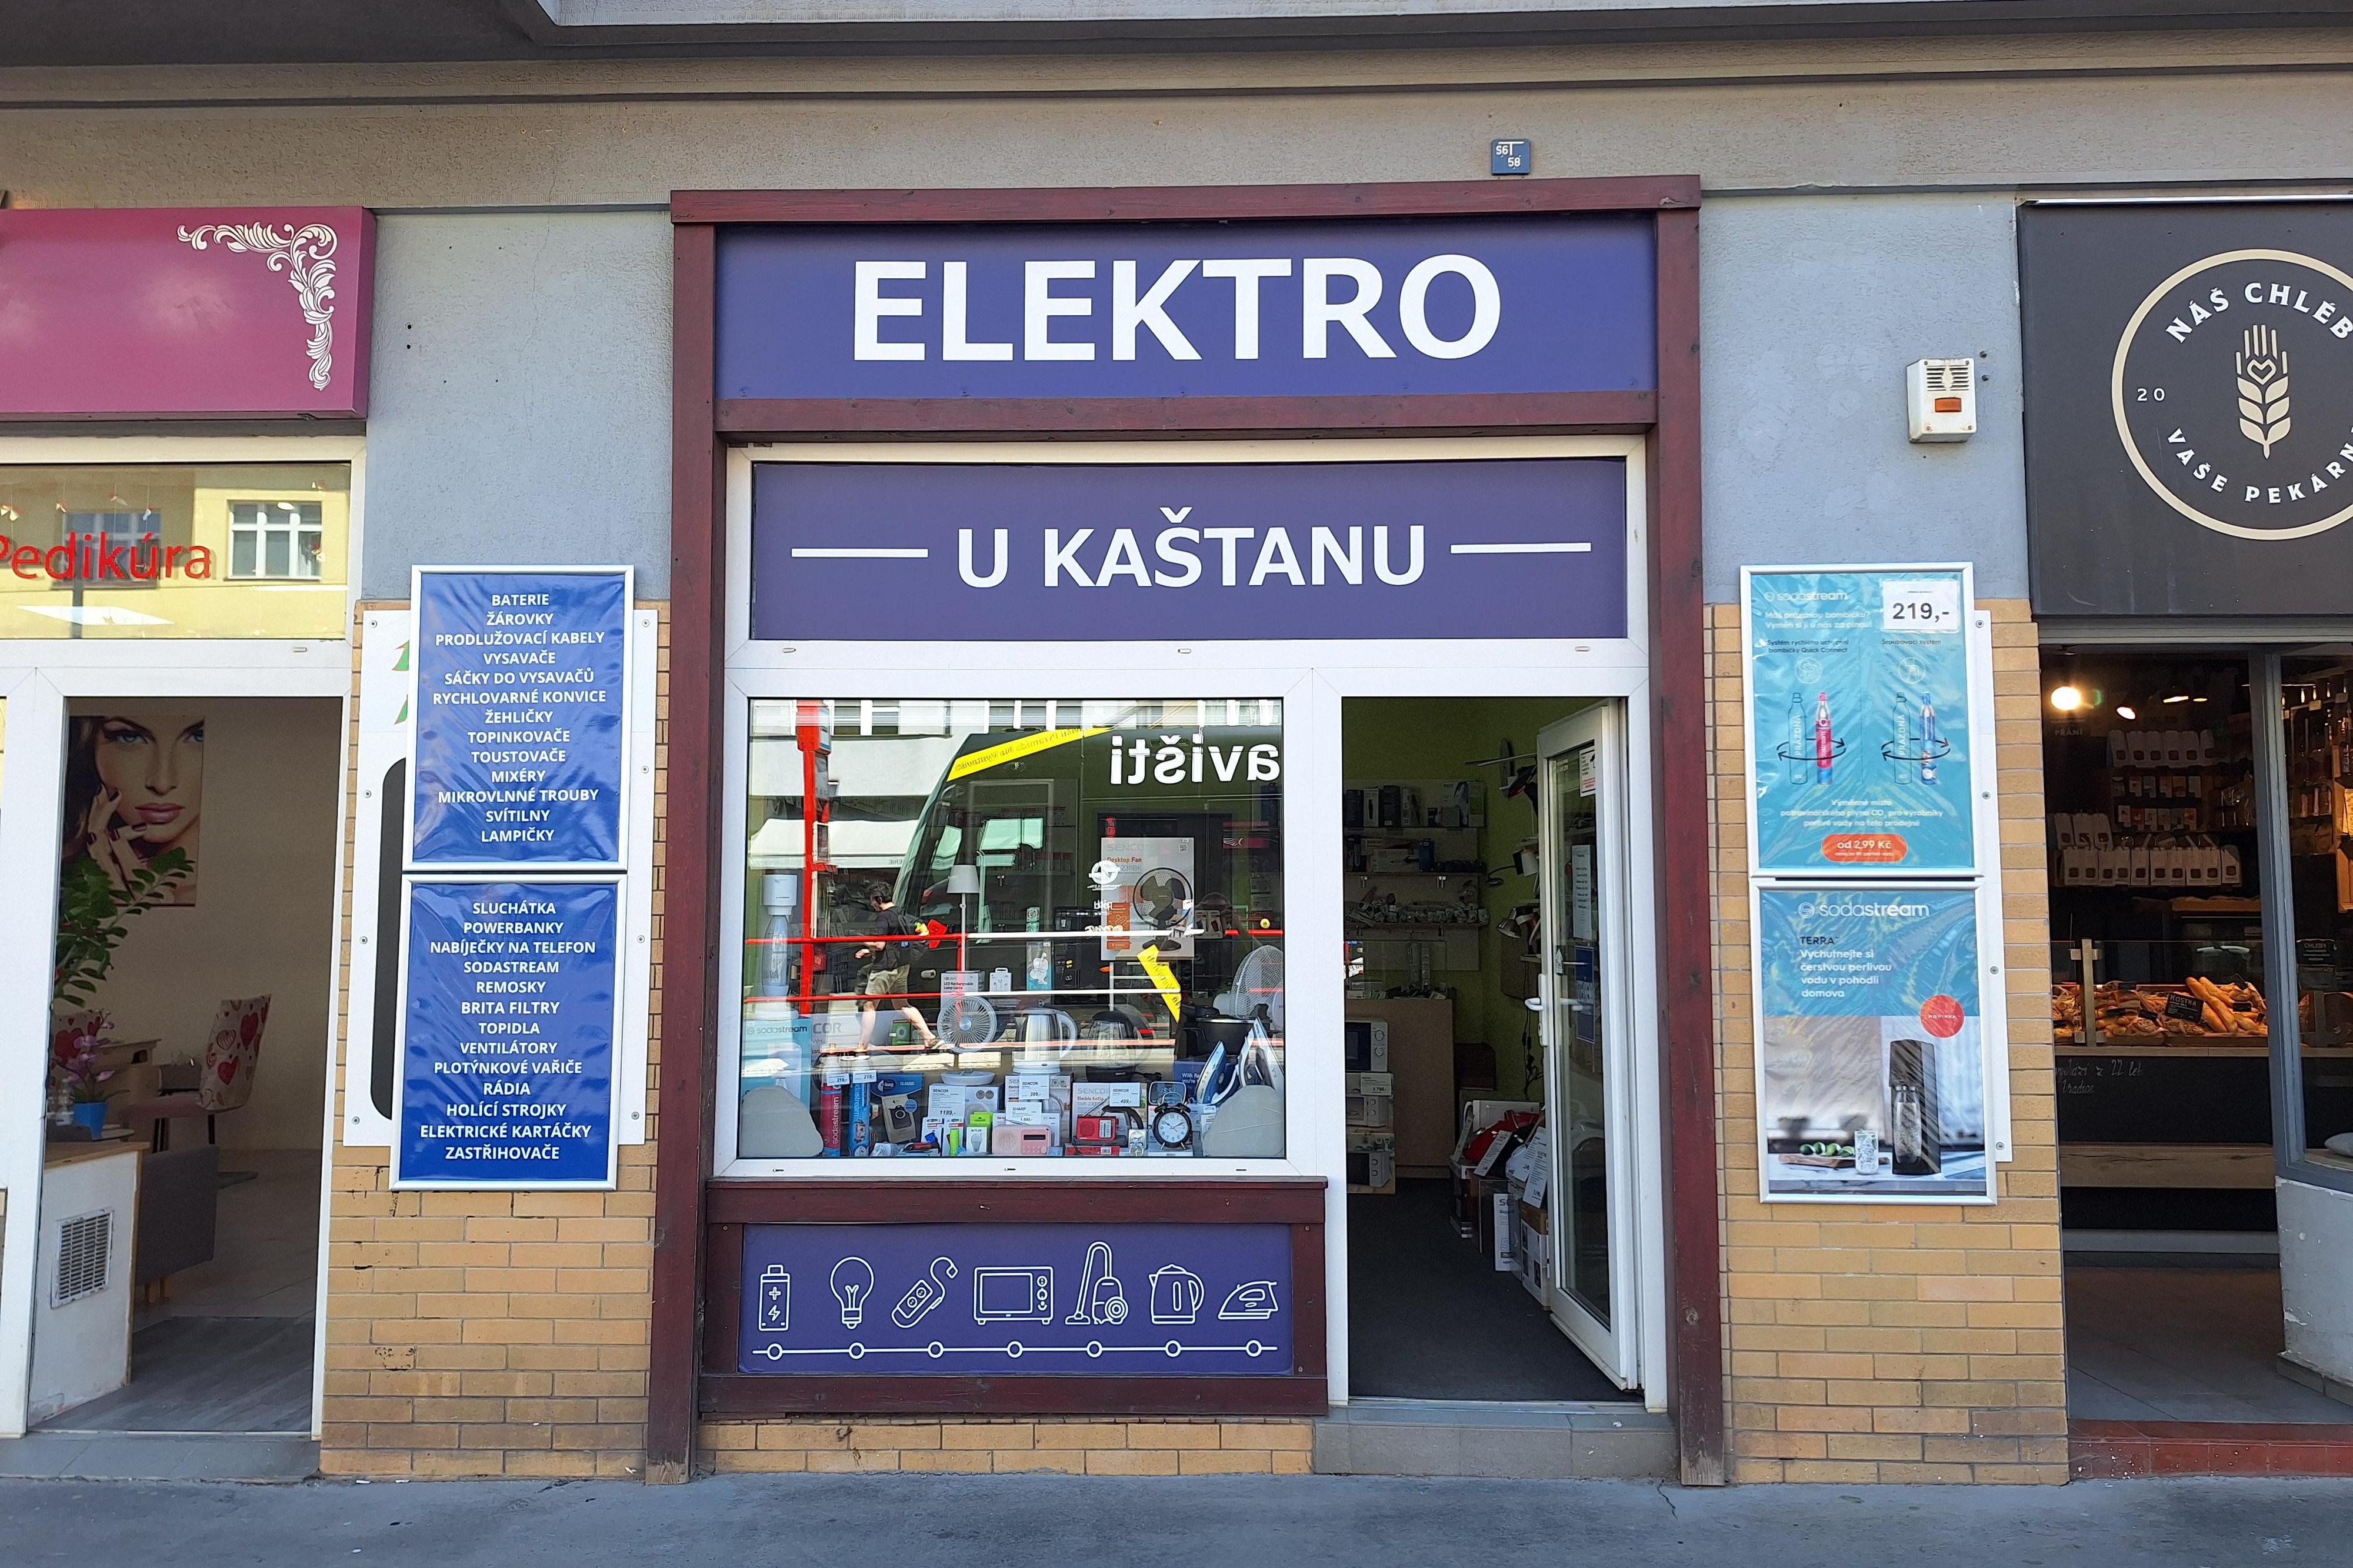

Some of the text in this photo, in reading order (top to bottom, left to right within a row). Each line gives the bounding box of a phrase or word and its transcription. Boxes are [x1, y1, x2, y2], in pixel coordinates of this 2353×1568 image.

[1508, 157, 1521, 167] 58
[854, 255, 1501, 361] ELEKTRO
[2165, 282, 2353, 343] NÁŠ CHLÉB
[2167, 426, 2353, 504] VAŠE PEKÁRN
[958, 506, 1425, 588] U KAŠTANU
[0, 531, 211, 579] edikúra
[492, 595, 548, 606] BATERIE
[1777, 592, 1847, 600] sodastream
[487, 612, 553, 625] ŽÁROVKY
[1892, 602, 1949, 622] 219,-
[436, 630, 604, 645] PRODLUŽOVACÍ KABELY
[484, 650, 555, 664] VYSAVAČE
[445, 668, 594, 684] SÁČKY DO VYSAVAČŮ
[434, 689, 605, 704] RYCHLOVARNÉ KONVICE
[485, 709, 552, 723] ŽEHLIČKY
[468, 728, 569, 743] TOPINKOVAČE
[472, 748, 565, 762] TOUSTOVAČE
[492, 768, 545, 782] MIXÉRY
[439, 788, 598, 803] MIKROVLNNÉ TROUBY
[486, 808, 549, 822] SVÍTILNY
[482, 828, 554, 842] LAMPIČKY
[1854, 841, 1875, 849] 2,99
[1878, 840, 1892, 849] Kč
[473, 900, 555, 913] SLUCHÁTKA
[1819, 903, 1929, 917] sodastream
[464, 922, 563, 933] POWERBANKY
[431, 939, 595, 956] NABÍJEČKY NA TELEFON
[1800, 949, 1874, 960] Vychutnejte si
[464, 962, 558, 972] SODASTREAM
[1800, 963, 1891, 973] čerstvou perlivou
[477, 982, 545, 993] REMOSKY
[1801, 989, 1845, 997] domova
[462, 1002, 559, 1013] BRITA FILTRY
[479, 1023, 539, 1033] TOPIDLA
[813, 1023, 842, 1034] COR
[461, 1040, 557, 1053] VENTILÁTORY
[435, 1060, 582, 1073] PLOTÝNKOVÉ VAŘIČE
[484, 1080, 530, 1095] RÁDIA
[447, 1101, 566, 1119] HOLÍCÍ STROJKY
[421, 1123, 591, 1137] ELEKTRICKÉ KARTÁČKY
[446, 1144, 559, 1159] ZASTŘIHOVAČE
